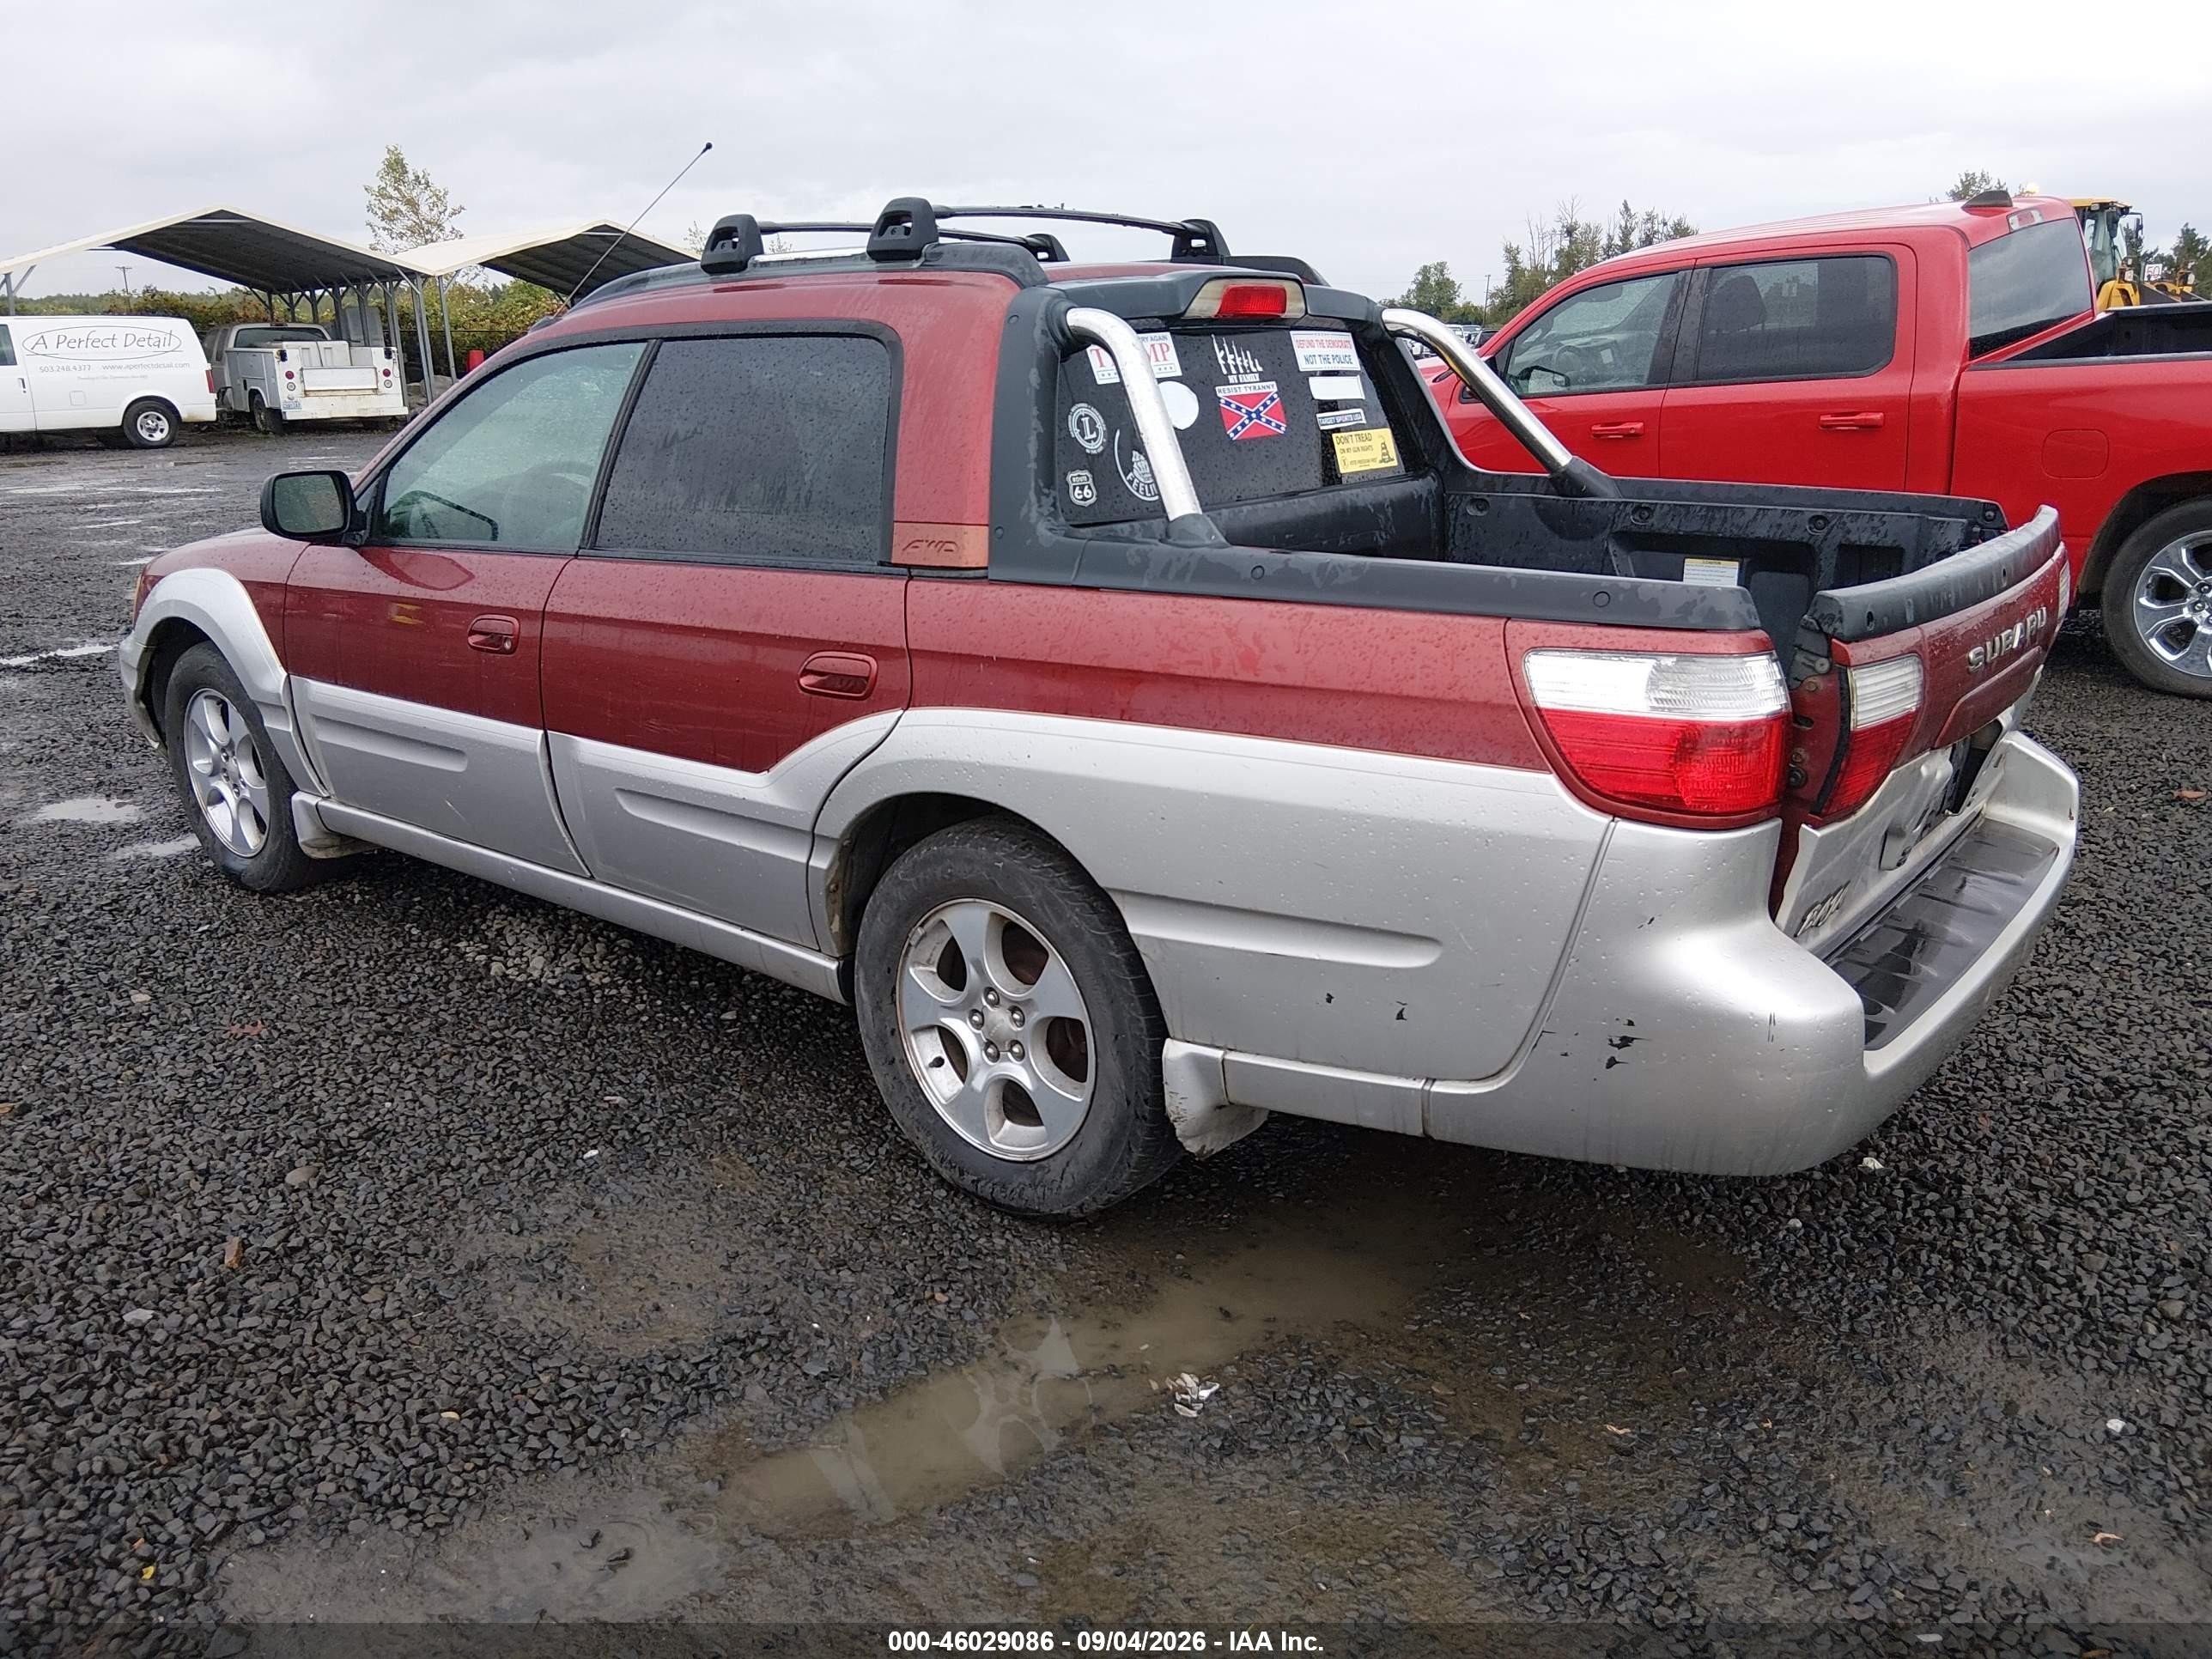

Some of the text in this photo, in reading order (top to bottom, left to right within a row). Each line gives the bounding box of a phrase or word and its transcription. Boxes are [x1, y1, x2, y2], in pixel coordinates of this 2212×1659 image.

[31, 330, 173, 350] A Perfect Detail
[1296, 338, 1352, 349] DEFUND THE DEMOCRATS
[1304, 354, 1353, 365] NOT THE POLICE
[40, 364, 92, 373] 503.248.4377
[1244, 383, 1275, 392] TYRANNY
[1081, 416, 1097, 440] L
[1335, 432, 1372, 445] DON'T TREAD
[1074, 484, 1092, 500] 66
[1967, 606, 2047, 674] SUBARU
